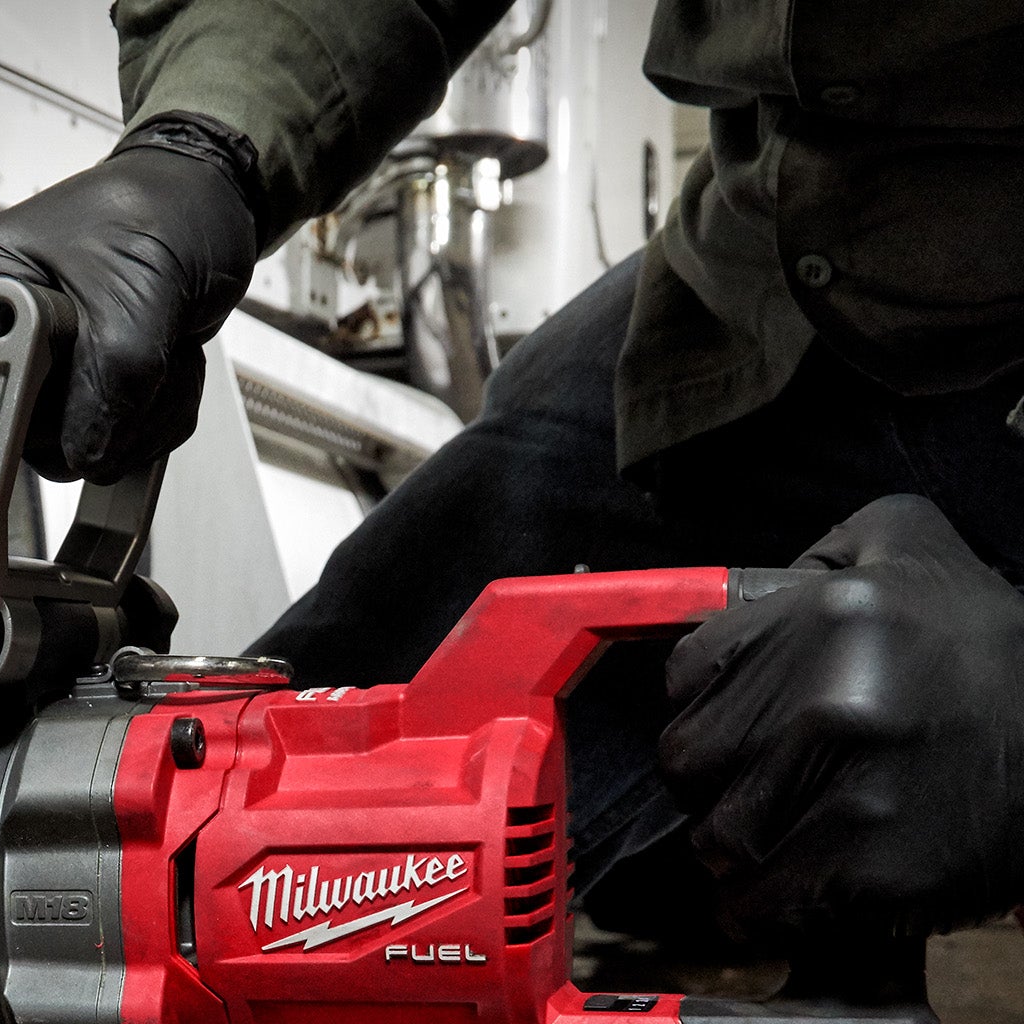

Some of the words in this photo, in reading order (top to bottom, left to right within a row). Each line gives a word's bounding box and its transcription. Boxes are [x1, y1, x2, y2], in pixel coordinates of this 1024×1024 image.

[237, 854, 468, 932] Milwaukee
[15, 894, 89, 922] M18
[385, 944, 488, 962] FUEL
